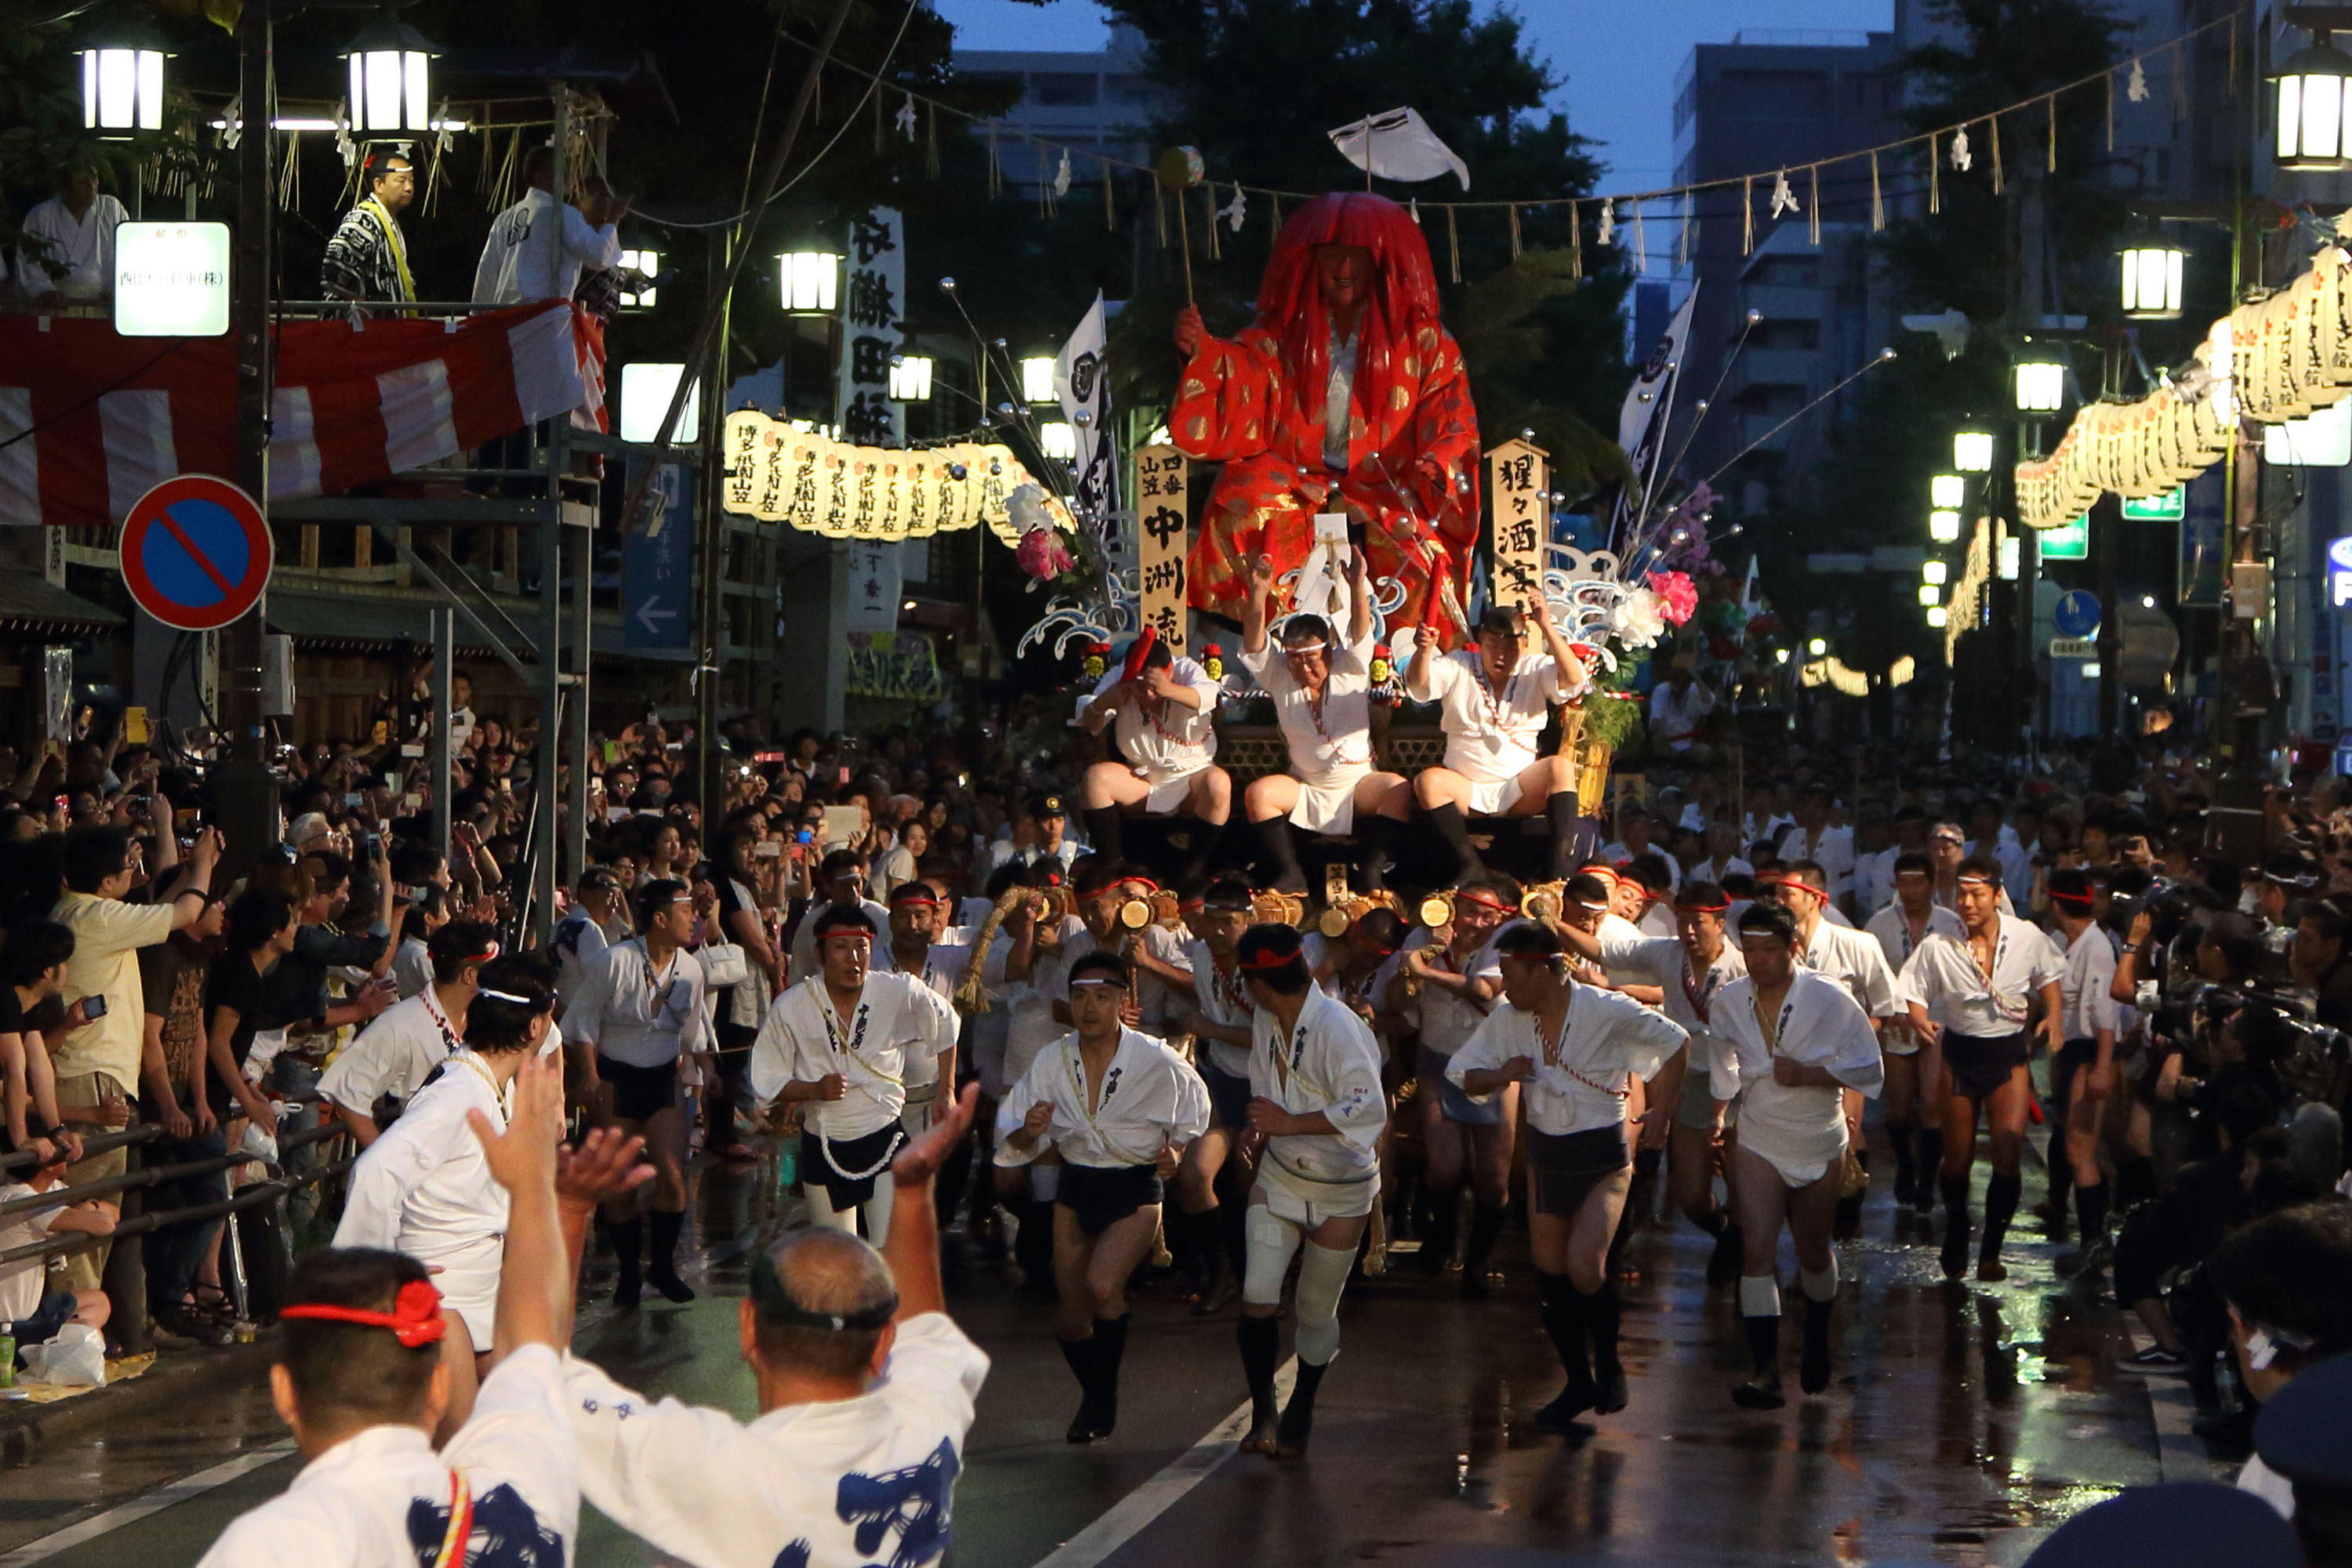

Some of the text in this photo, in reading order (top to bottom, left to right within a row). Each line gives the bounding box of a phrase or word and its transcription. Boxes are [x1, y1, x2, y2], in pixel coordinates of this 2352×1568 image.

[1141, 456, 1162, 498] 山笠
[1161, 455, 1185, 497] 四番
[1144, 506, 1185, 648] 中洲流
